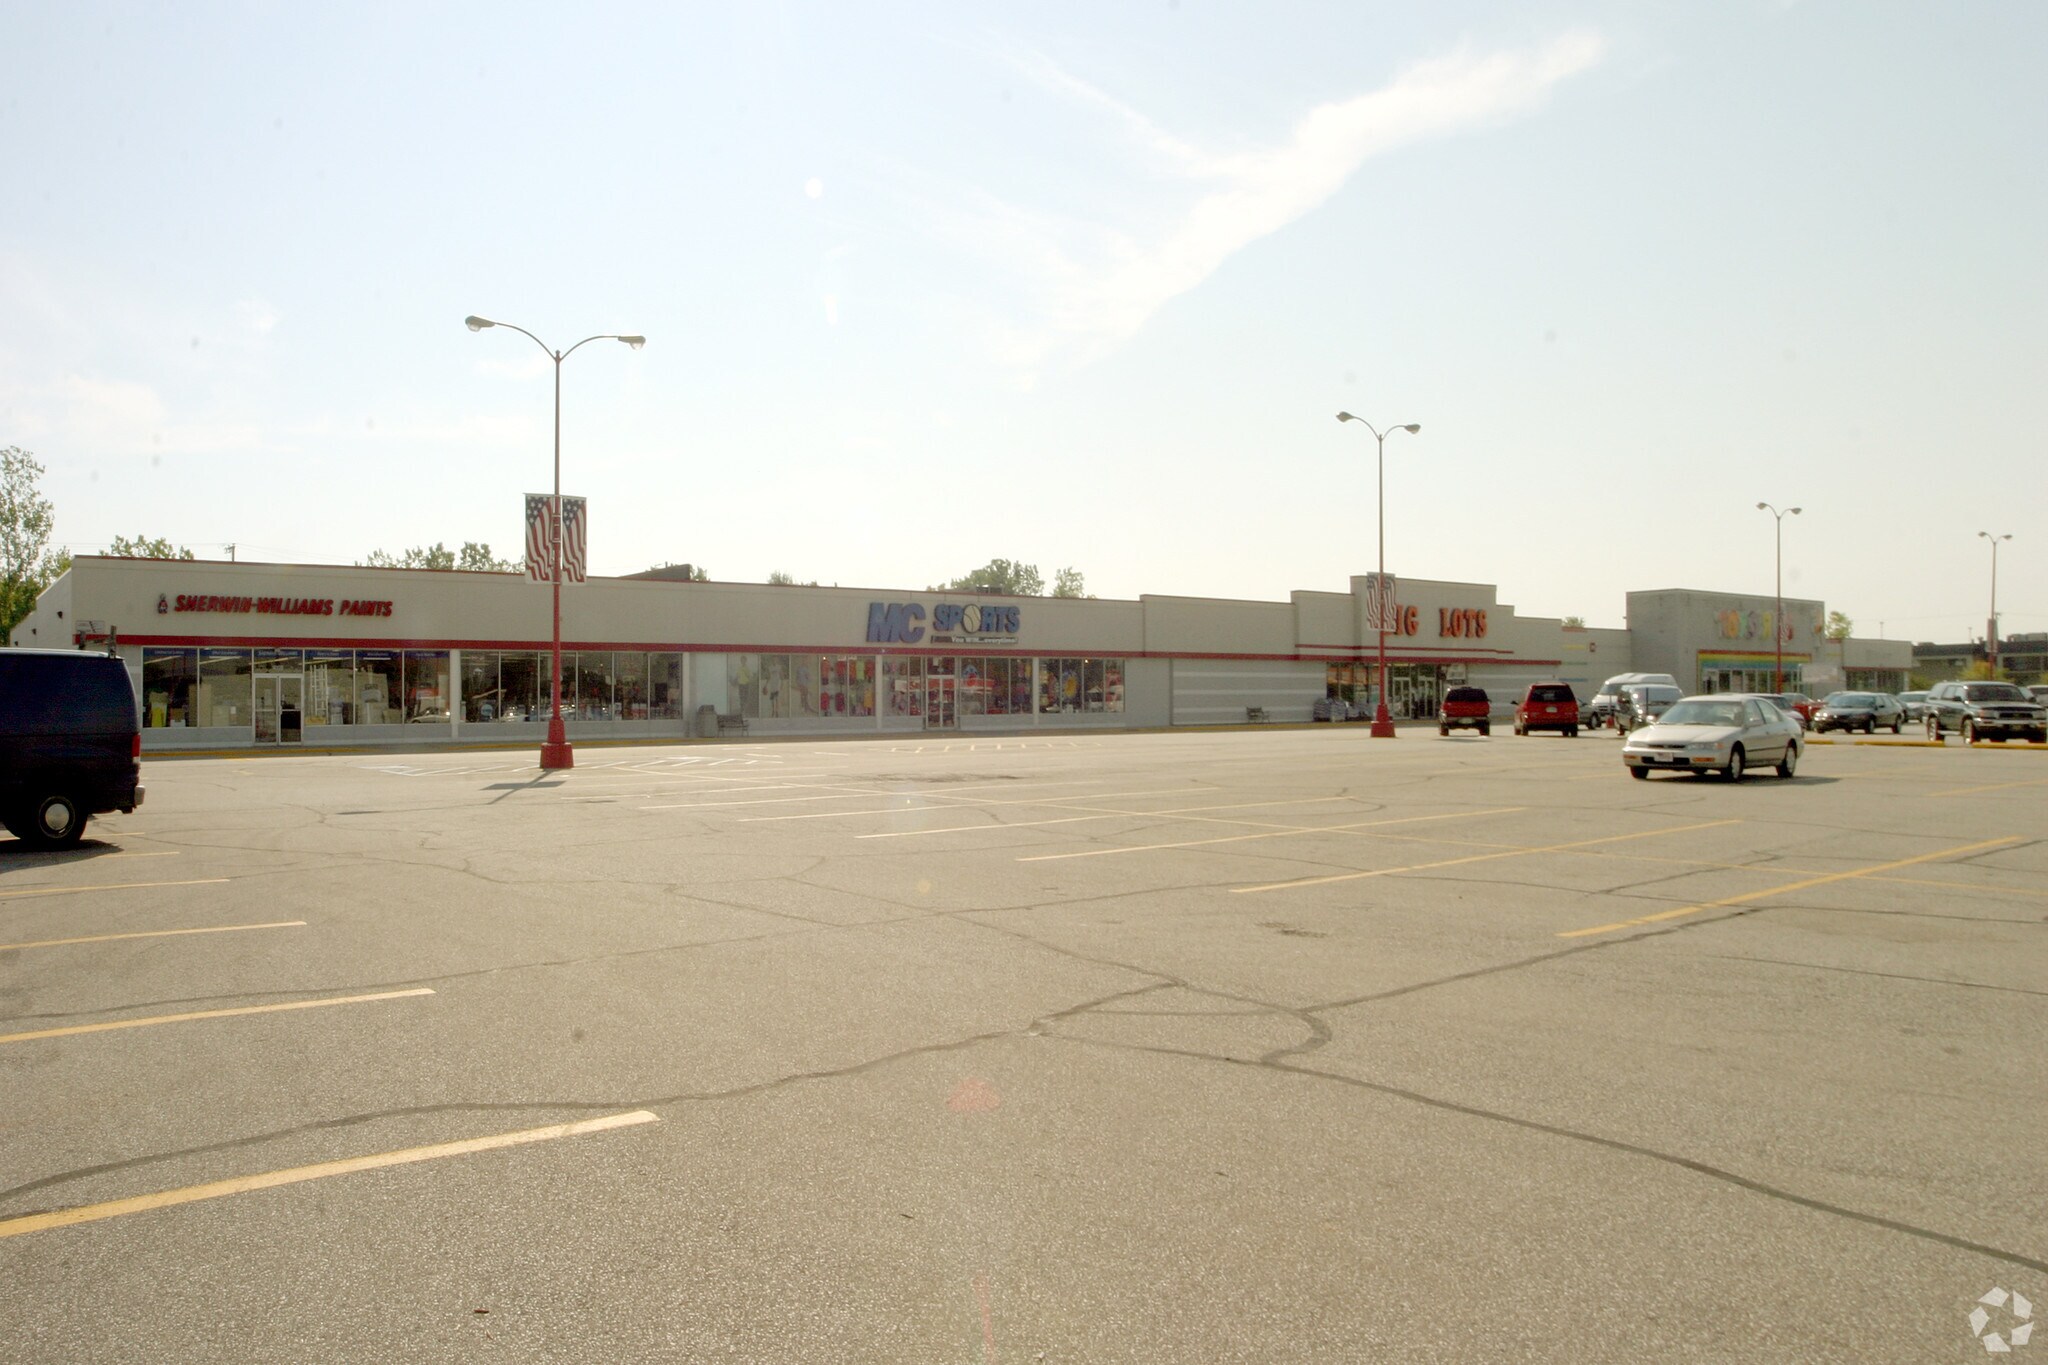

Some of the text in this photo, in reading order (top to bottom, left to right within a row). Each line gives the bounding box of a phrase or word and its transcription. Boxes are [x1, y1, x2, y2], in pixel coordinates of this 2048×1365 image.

[174, 594, 393, 617] SHERWIN-WILLIAMS PAINTS
[866, 602, 1021, 644] MC SPORTS
[1439, 607, 1488, 638] LOTS
